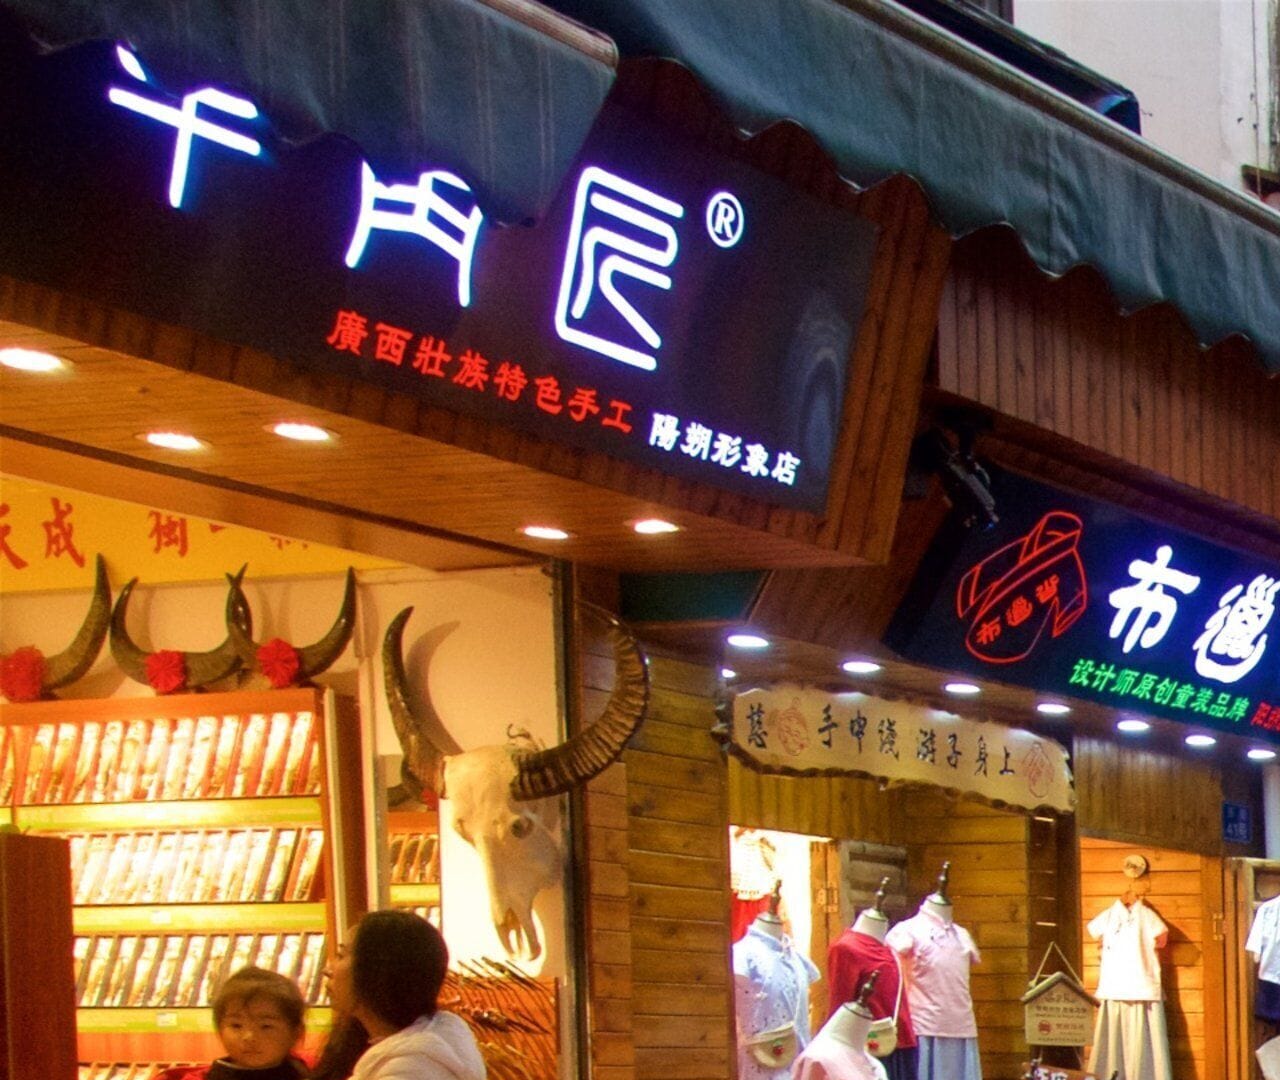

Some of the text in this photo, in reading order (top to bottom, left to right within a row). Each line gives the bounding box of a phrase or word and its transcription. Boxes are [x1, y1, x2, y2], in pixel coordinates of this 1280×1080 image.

[1069, 657, 1251, 722] 设计师原创童装品牌
